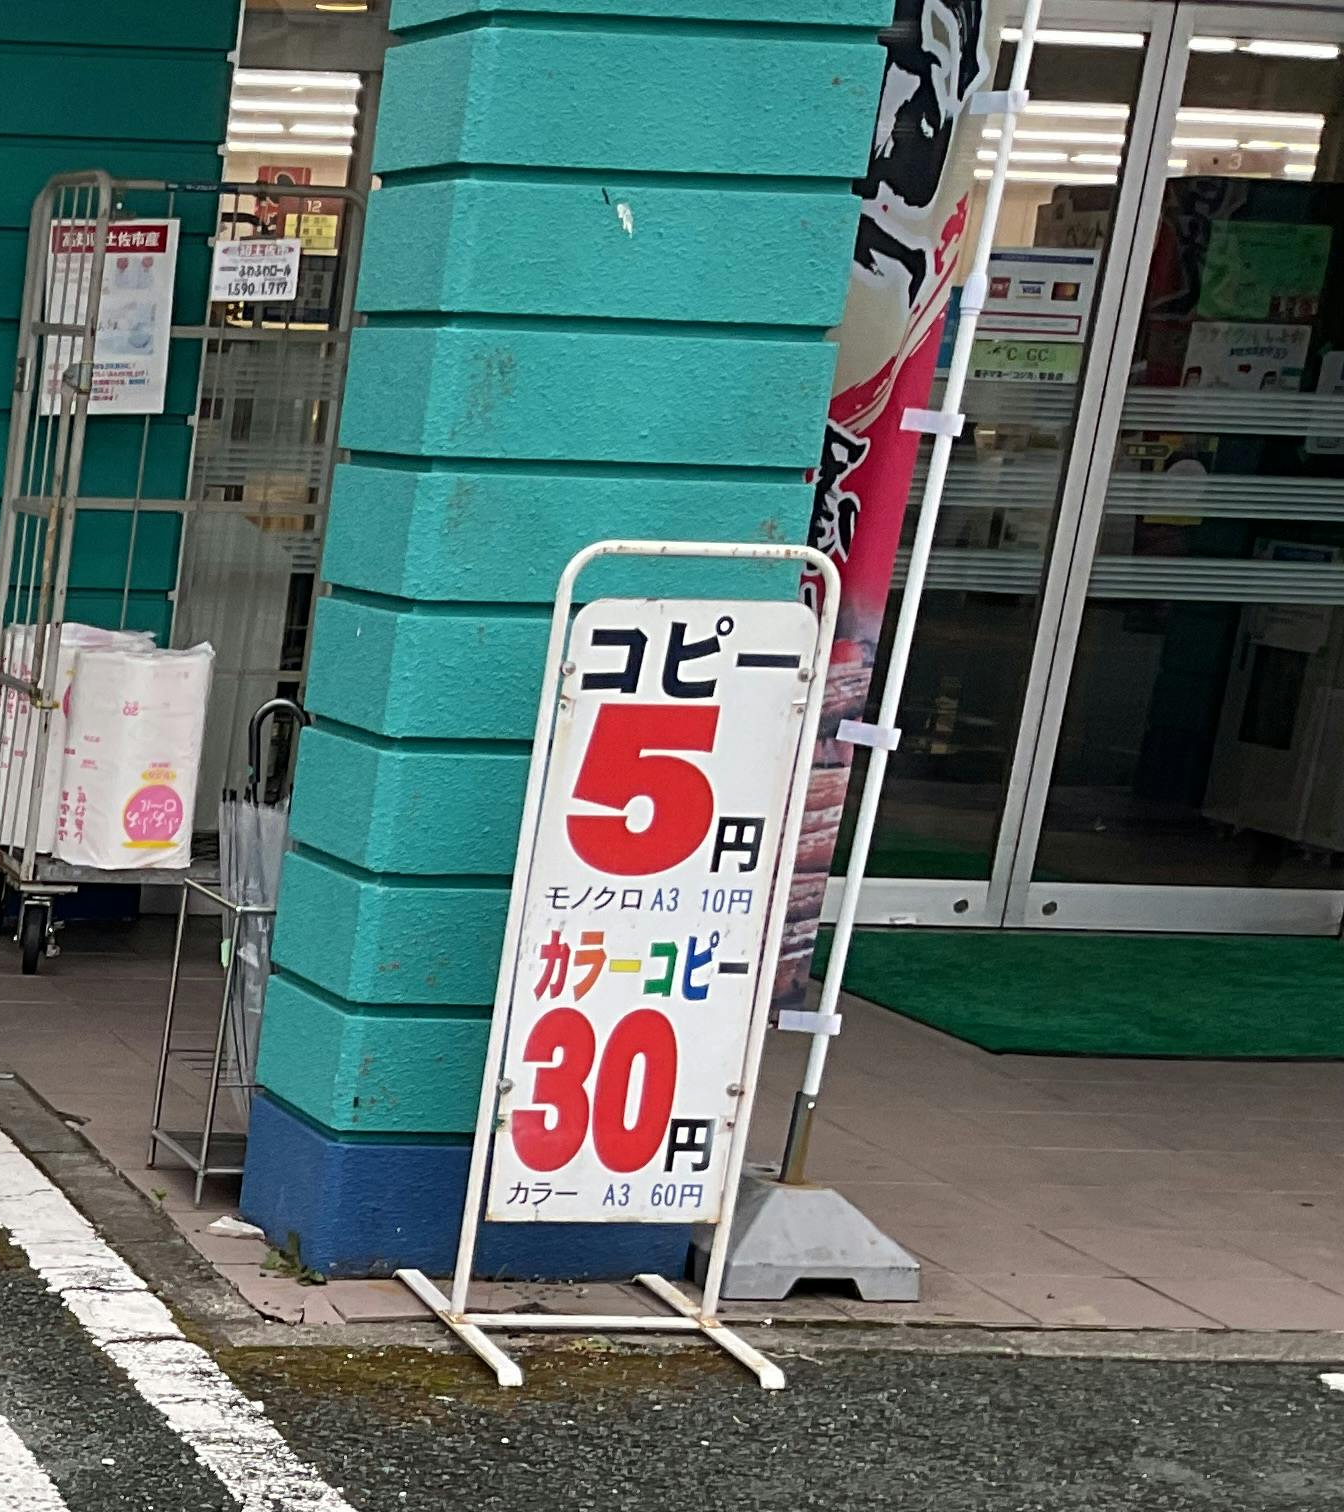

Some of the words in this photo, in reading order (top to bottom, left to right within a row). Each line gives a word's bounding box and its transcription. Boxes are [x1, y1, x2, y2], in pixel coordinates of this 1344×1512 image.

[307, 200, 322, 213] 12
[1022, 286, 1041, 294] VISA
[581, 616, 802, 700] コピー
[566, 703, 765, 876] 5円
[545, 886, 643, 912] モノクロ
[650, 887, 680, 912] A3
[701, 889, 753, 914] 10円
[534, 931, 750, 1002] カラーコピー
[511, 1007, 716, 1173] 30円
[505, 1181, 579, 1207] カラー
[602, 1183, 630, 1207] A3
[651, 1183, 703, 1208] 60円
